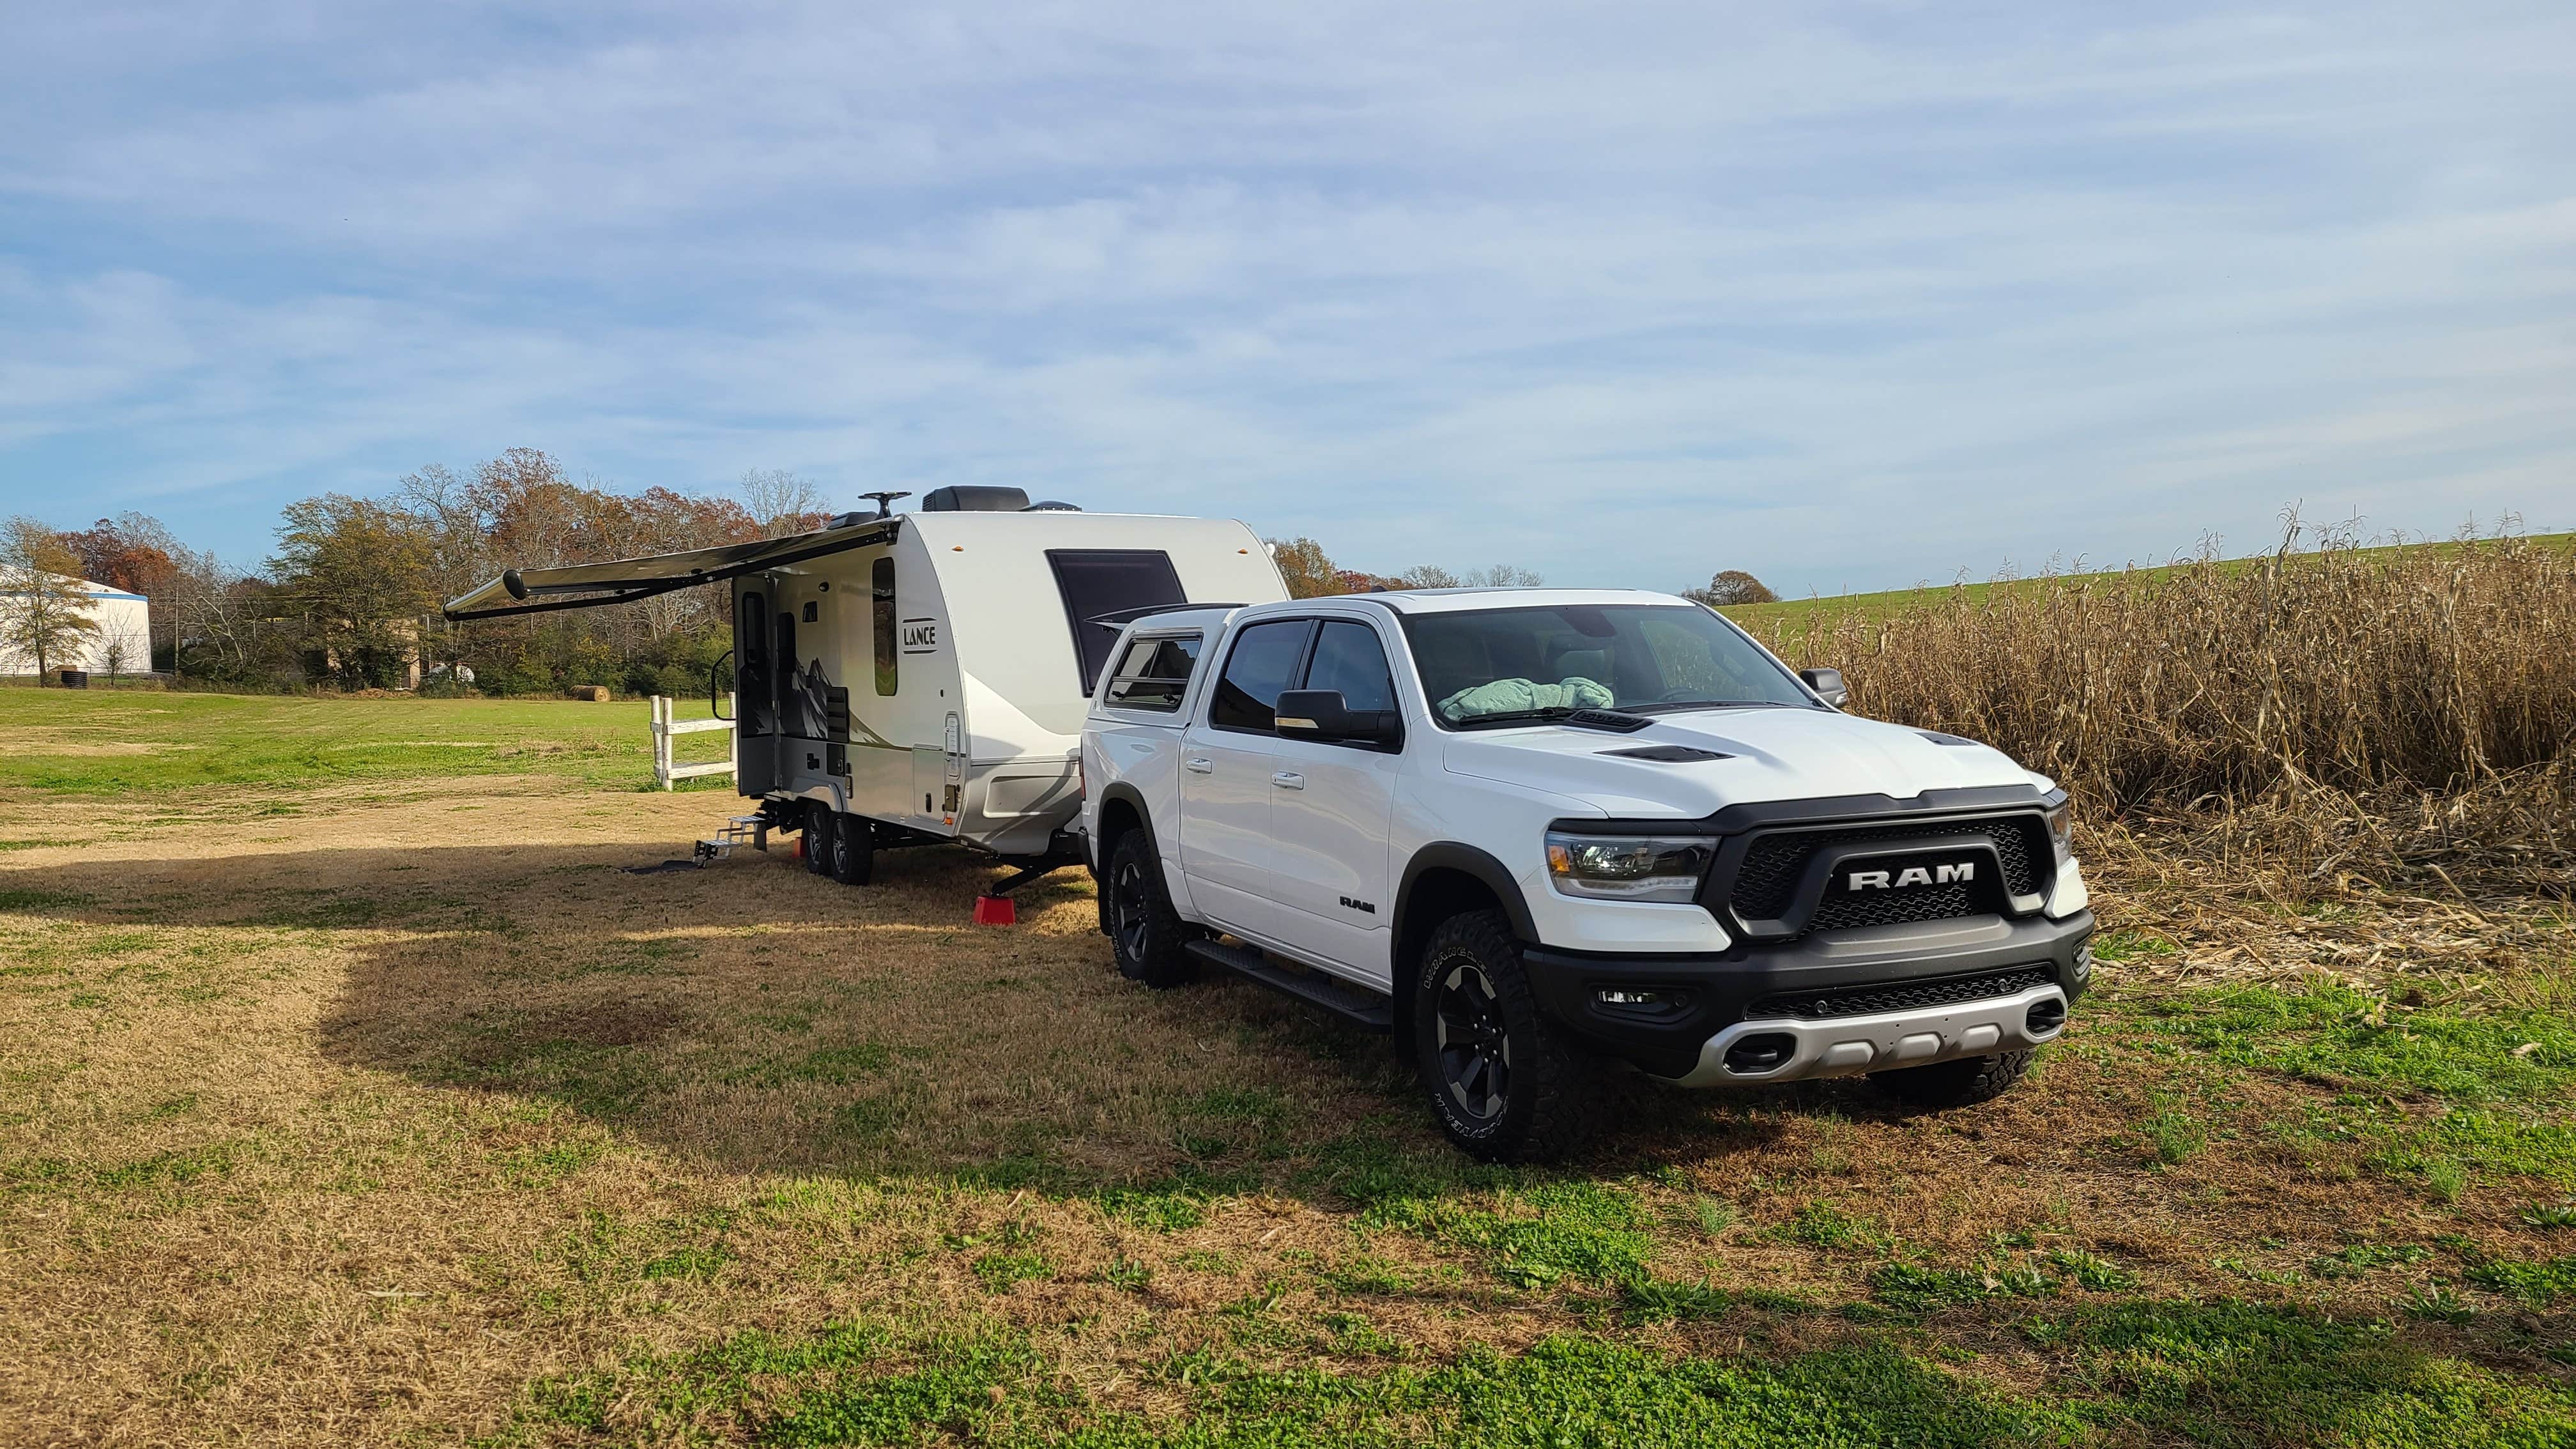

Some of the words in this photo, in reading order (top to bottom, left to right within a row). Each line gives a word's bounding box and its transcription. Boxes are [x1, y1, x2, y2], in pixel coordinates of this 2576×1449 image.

[903, 626, 936, 646] LANCE
[1848, 862, 1974, 891] RAM
[1340, 896, 1375, 914] RAM
[1423, 946, 1495, 990] WRANGLER
[1434, 1092, 1508, 1139] GOODYEAR
